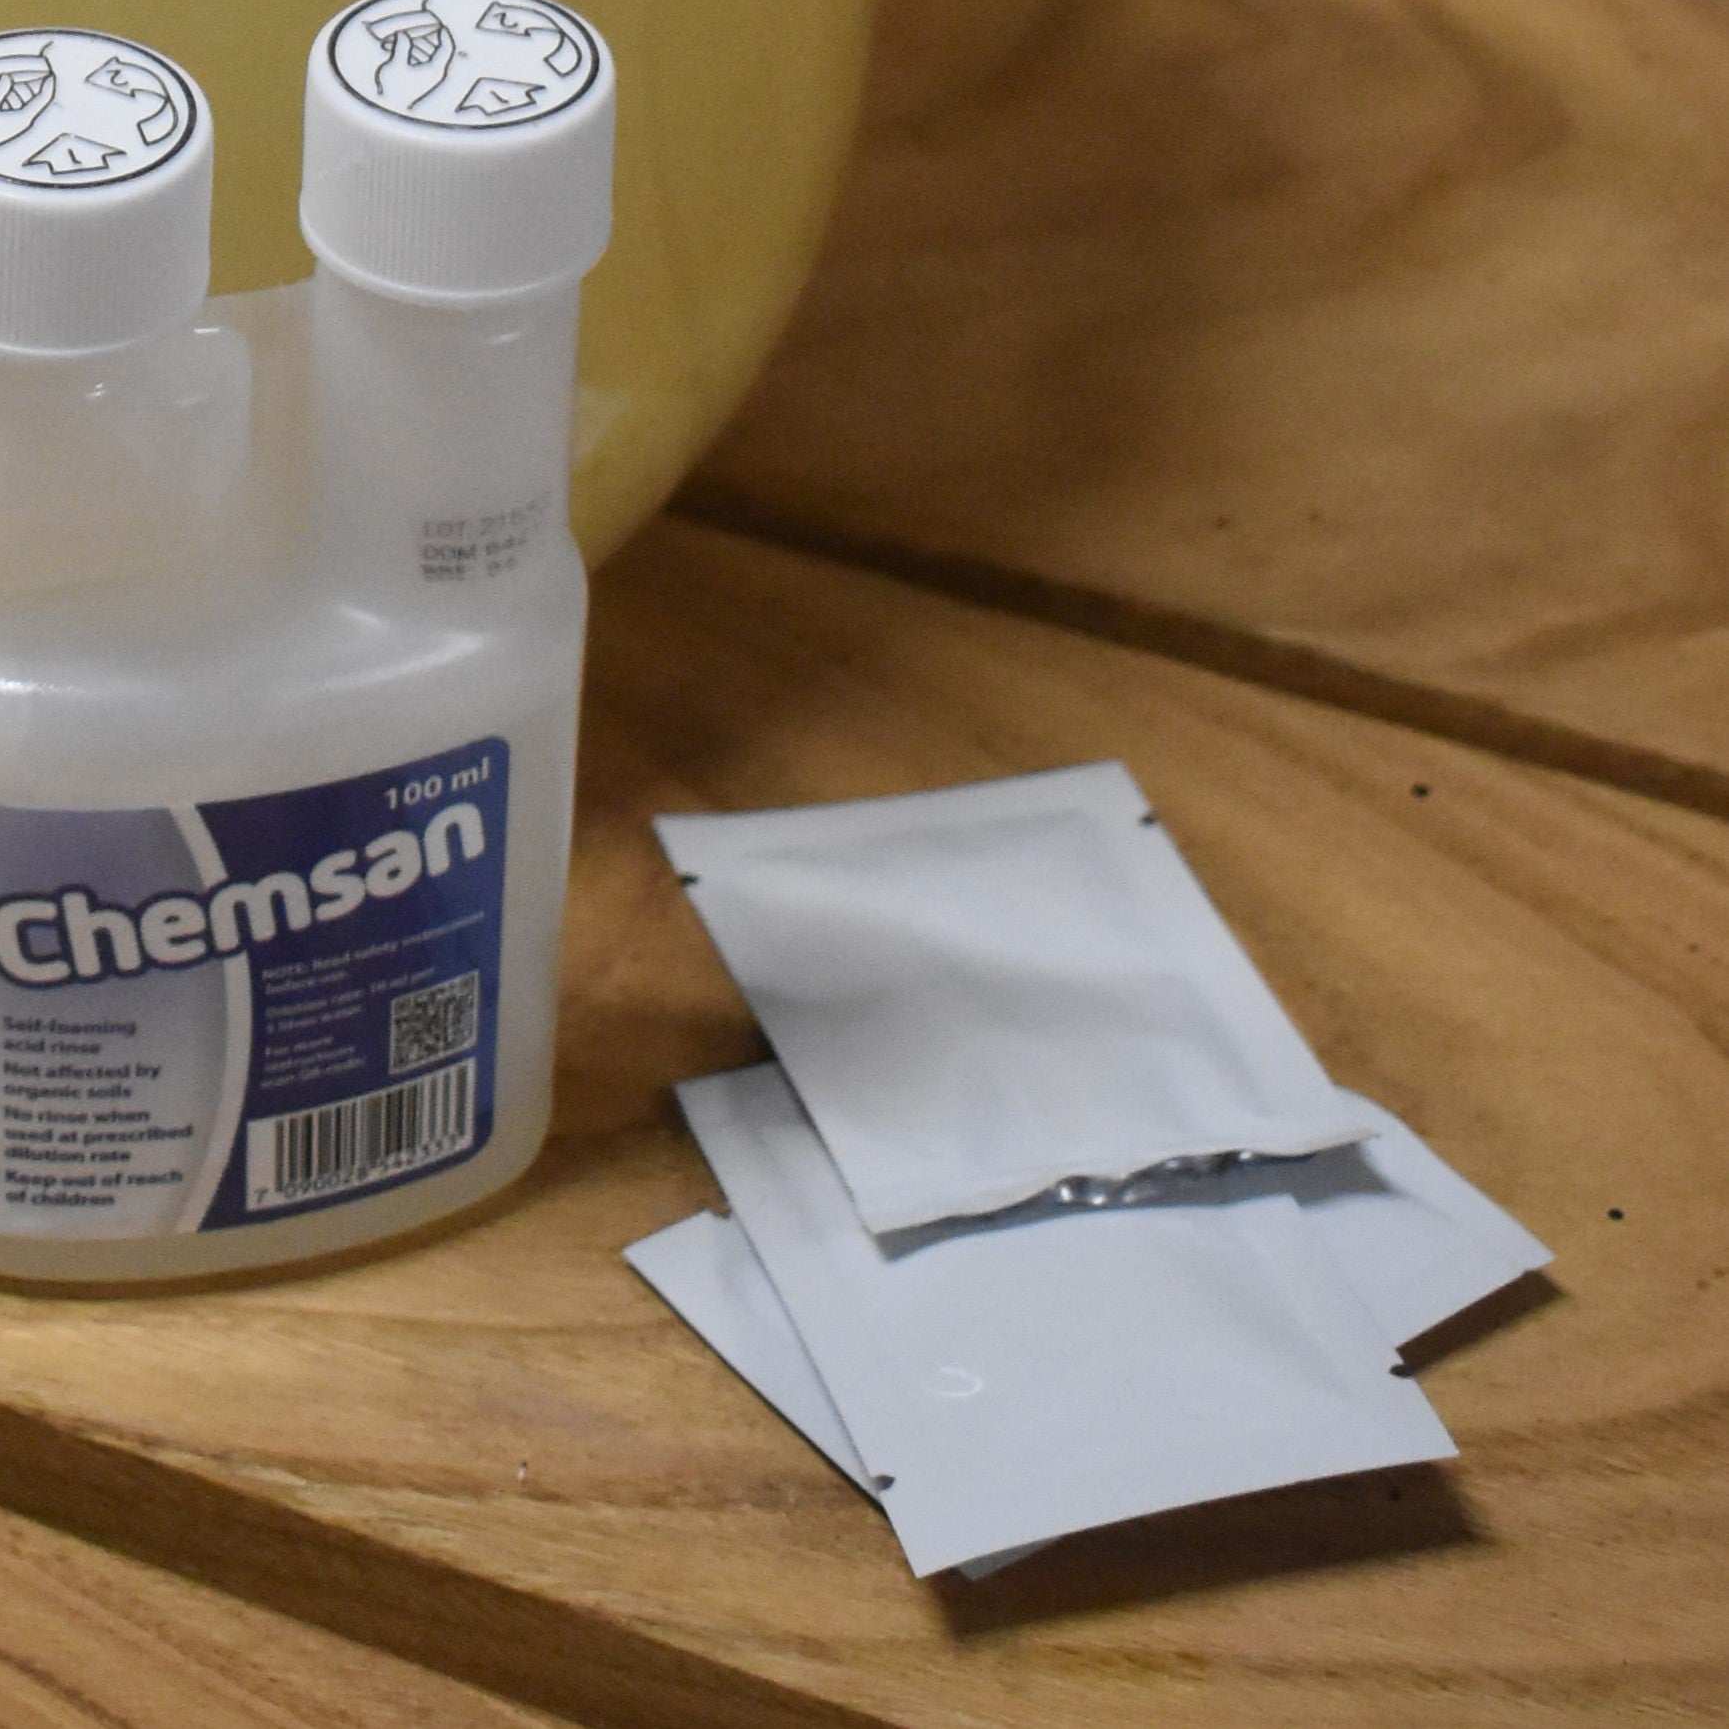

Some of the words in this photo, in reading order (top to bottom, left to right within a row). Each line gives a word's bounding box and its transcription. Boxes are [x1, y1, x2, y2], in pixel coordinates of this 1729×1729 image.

[383, 774, 443, 812] 100
[450, 757, 493, 792] ml
[3, 1015, 137, 1038] Self-foaming
[3, 1039, 45, 1053] acid
[50, 1040, 102, 1054] rinse
[3, 1060, 40, 1076] Not
[45, 1063, 131, 1079] affected
[135, 1061, 162, 1080] by
[3, 1084, 81, 1101] organic
[87, 1084, 133, 1098] soils
[4, 1105, 33, 1121] No
[37, 1110, 89, 1124] rinse
[93, 1109, 151, 1123] when
[4, 1128, 54, 1143] used
[58, 1130, 78, 1143] at
[83, 1123, 194, 1146] prescribed
[3, 1145, 86, 1162] dilution
[90, 1150, 132, 1163] rate
[5, 1169, 57, 1188] Keep
[61, 1174, 96, 1187] out
[100, 1171, 122, 1187] of
[126, 1168, 184, 1186] reach
[5, 1191, 26, 1204] of
[30, 1191, 116, 1206] children
